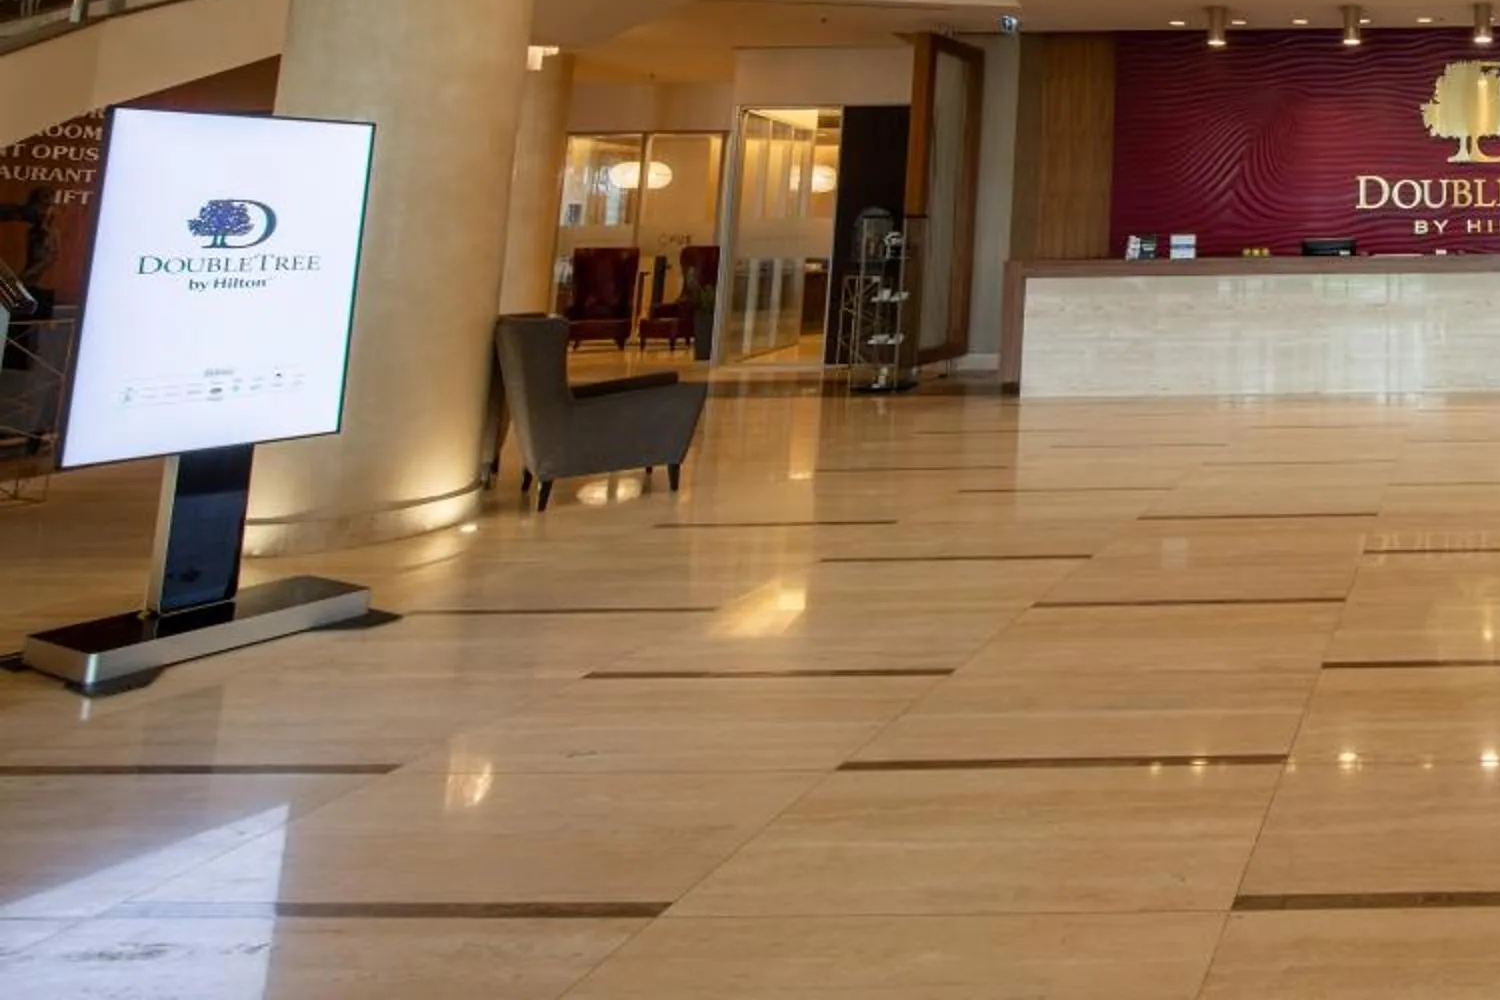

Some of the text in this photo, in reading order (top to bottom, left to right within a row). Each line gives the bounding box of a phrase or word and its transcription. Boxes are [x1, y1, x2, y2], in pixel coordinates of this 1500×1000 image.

[34, 123, 103, 141] OOM
[31, 143, 100, 162] OPUS
[53, 188, 95, 205] IFT
[1414, 219, 1449, 235] BY
[188, 276, 268, 292] by Hilton
